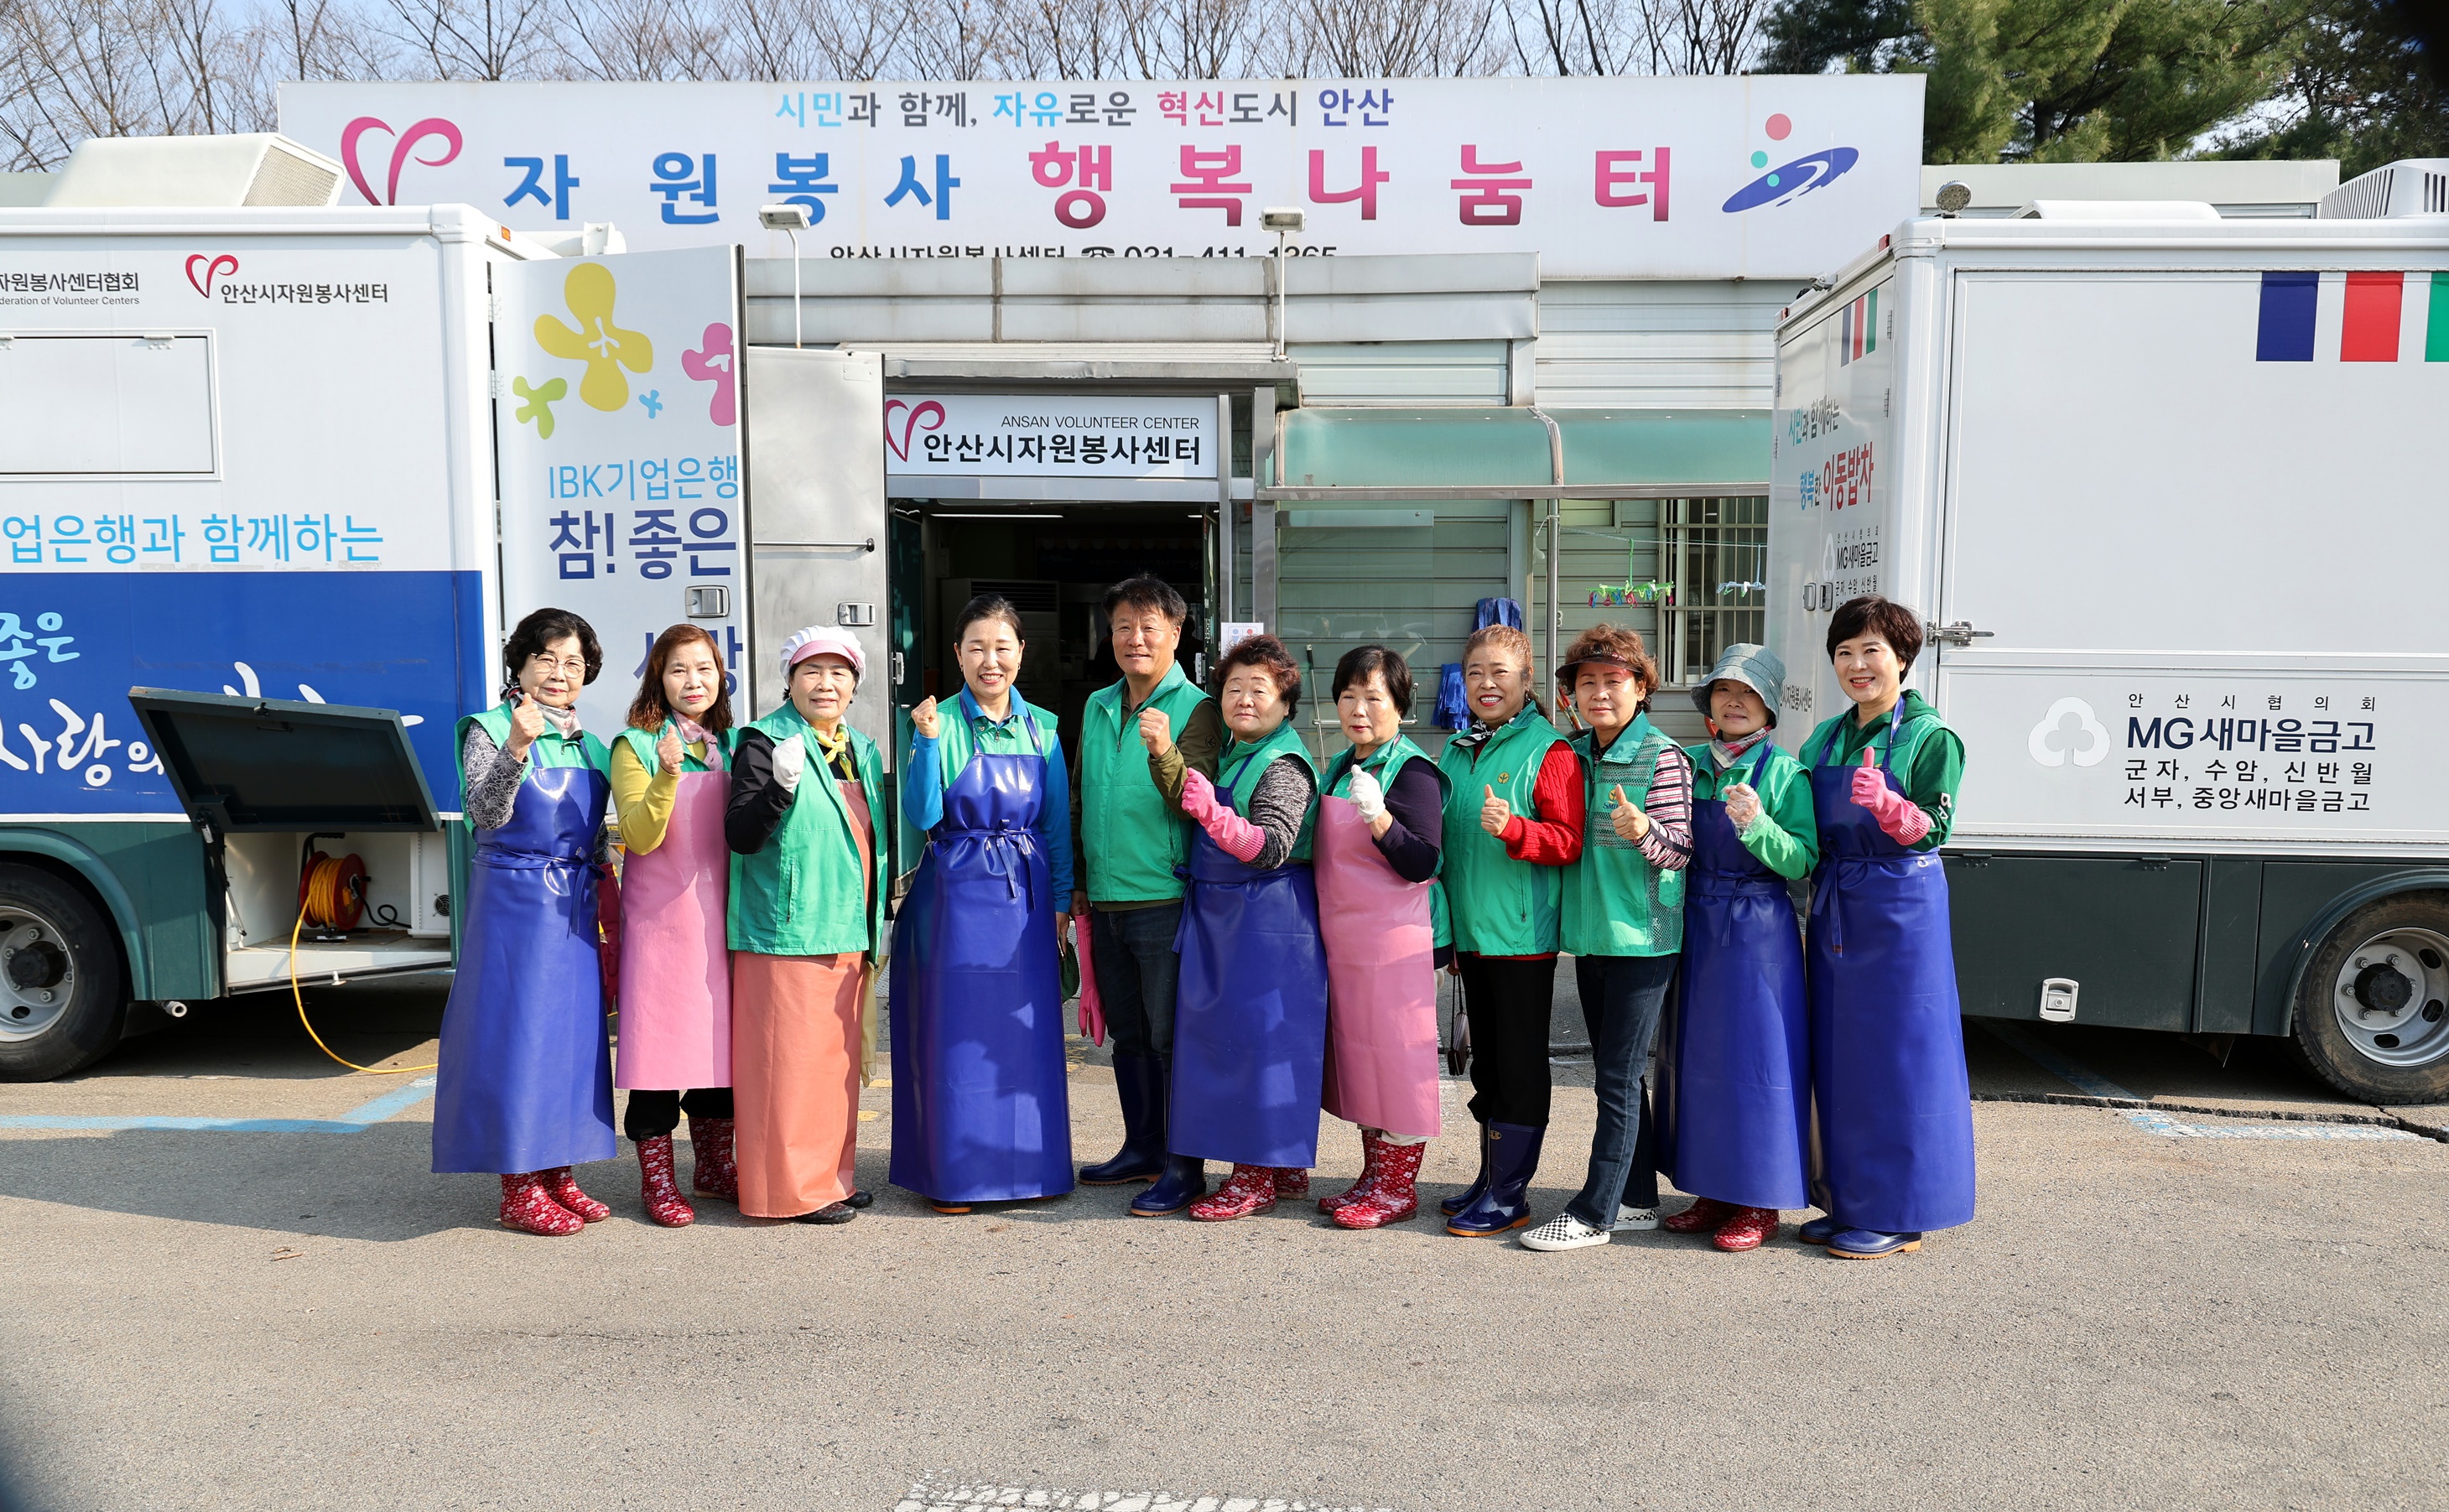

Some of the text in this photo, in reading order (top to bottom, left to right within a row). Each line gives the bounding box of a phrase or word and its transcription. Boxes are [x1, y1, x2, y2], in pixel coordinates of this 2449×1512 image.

[776, 89, 1394, 127] 시민과 함께, 자유로운 혁신도시 안산
[502, 139, 1672, 230] 자원봉사 행복나눔터
[0, 273, 138, 292] 자원봉사센터협회
[221, 284, 387, 304] 안산시자원봉사센터
[41, 296, 50, 305] of
[53, 296, 99, 305] Volunteer
[101, 296, 140, 305] Centers
[1001, 416, 1199, 429] ANSAN VOLUNTEER CENTER
[924, 434, 1199, 465] 안산시자원봉사센터
[549, 455, 738, 501] IBK기업은행
[1800, 441, 1874, 512] 행복한 이동밥차
[3, 514, 382, 564] 업은행과 함께하는
[549, 508, 736, 579] 참! 좋은
[1836, 542, 1879, 571] MG새마을금고
[0, 612, 80, 689] 좋은
[1780, 684, 1813, 714] 시자원봉사센터
[2128, 717, 2375, 753] MG새마을금고
[2125, 759, 2371, 784] 군자, 수암, 신반월
[2124, 787, 2369, 812] 서부, 중앙새마을금고
